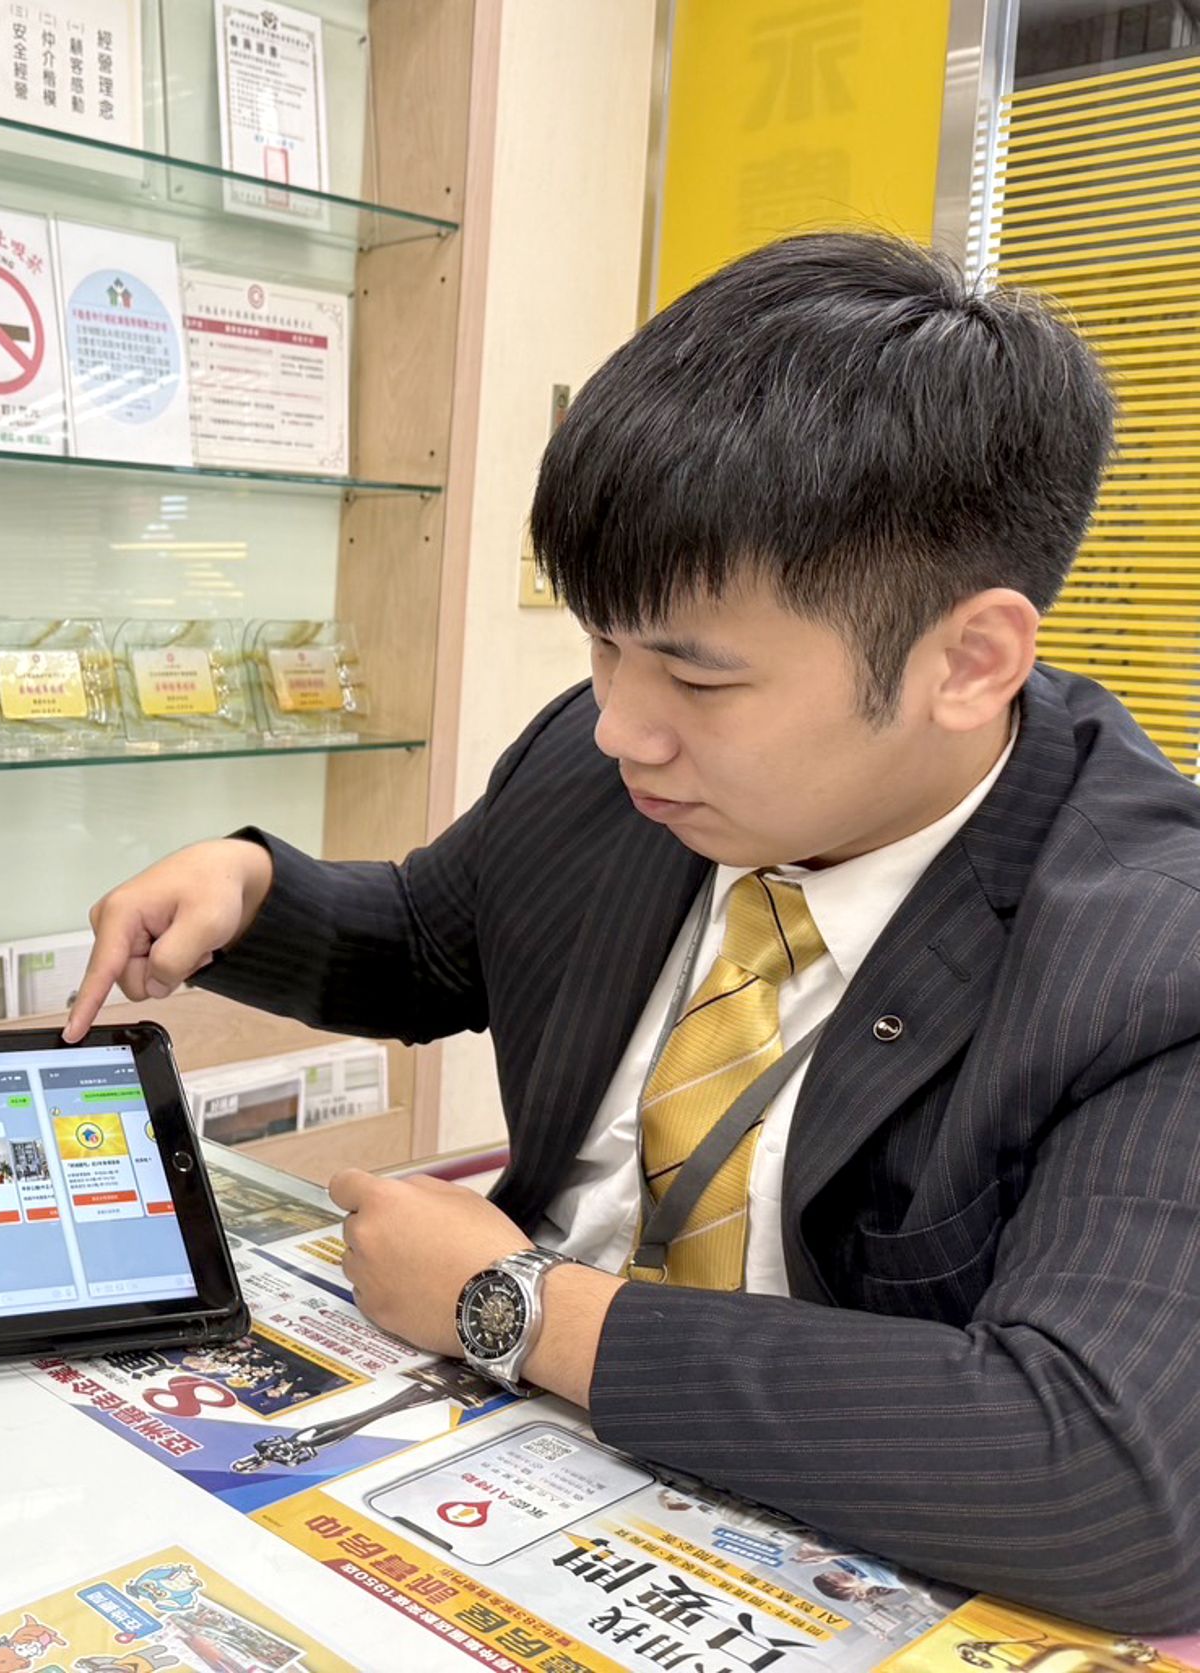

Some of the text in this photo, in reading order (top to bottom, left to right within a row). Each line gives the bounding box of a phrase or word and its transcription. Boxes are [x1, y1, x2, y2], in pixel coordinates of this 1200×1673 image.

[97, 29, 114, 120] 經營理念
[304, 1514, 460, 1606] 誠實房仲
[553, 1538, 818, 1672] 只要問
